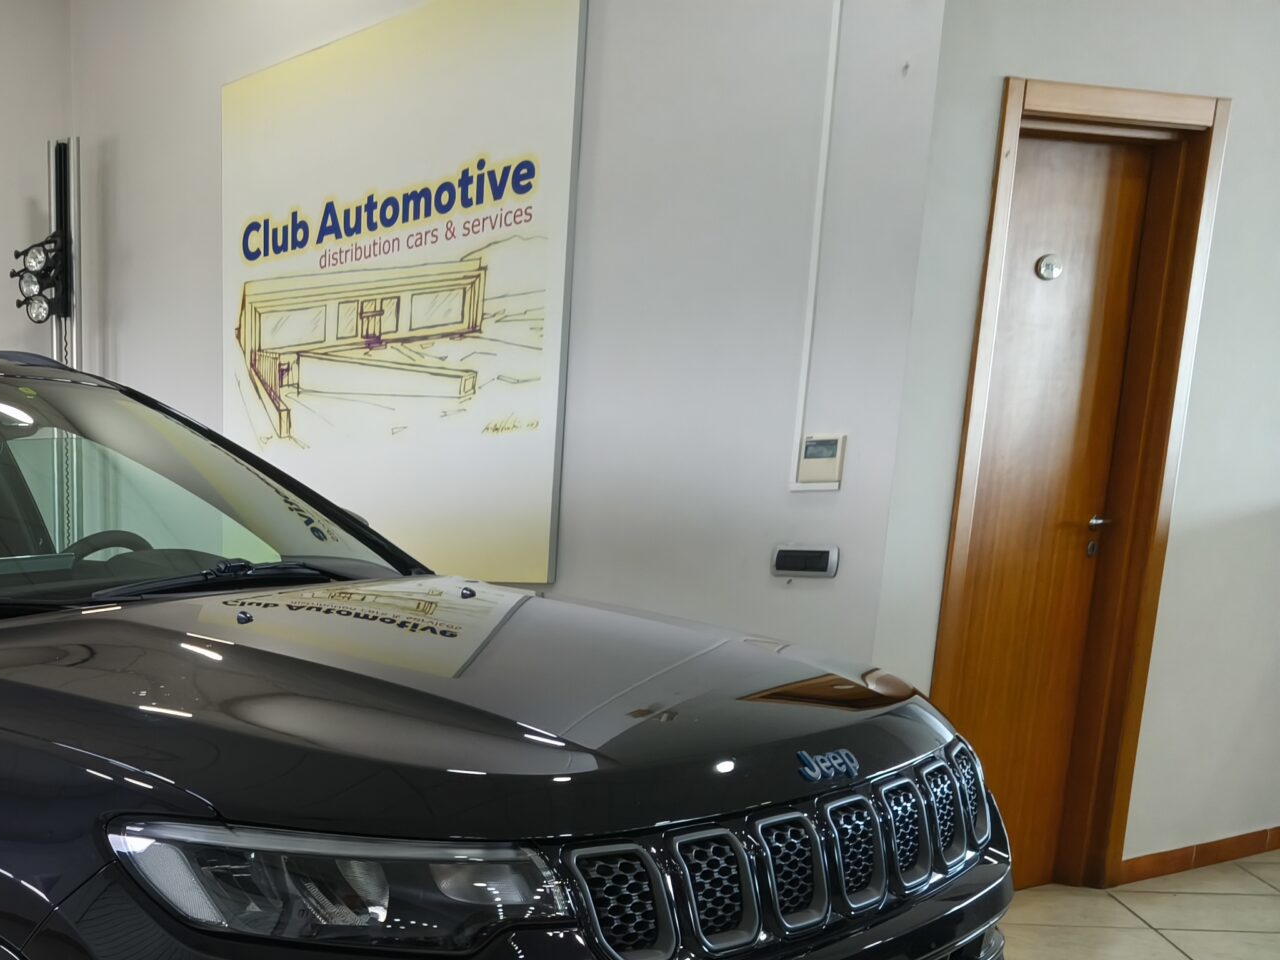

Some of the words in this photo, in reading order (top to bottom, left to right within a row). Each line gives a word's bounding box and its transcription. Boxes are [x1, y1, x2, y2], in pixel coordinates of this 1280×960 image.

[242, 211, 310, 261] Club
[316, 158, 536, 245] Automotive
[318, 236, 400, 269] distribution
[406, 227, 439, 250] cars
[445, 220, 457, 241] &
[462, 206, 533, 237] services
[796, 748, 860, 783] Jeep
